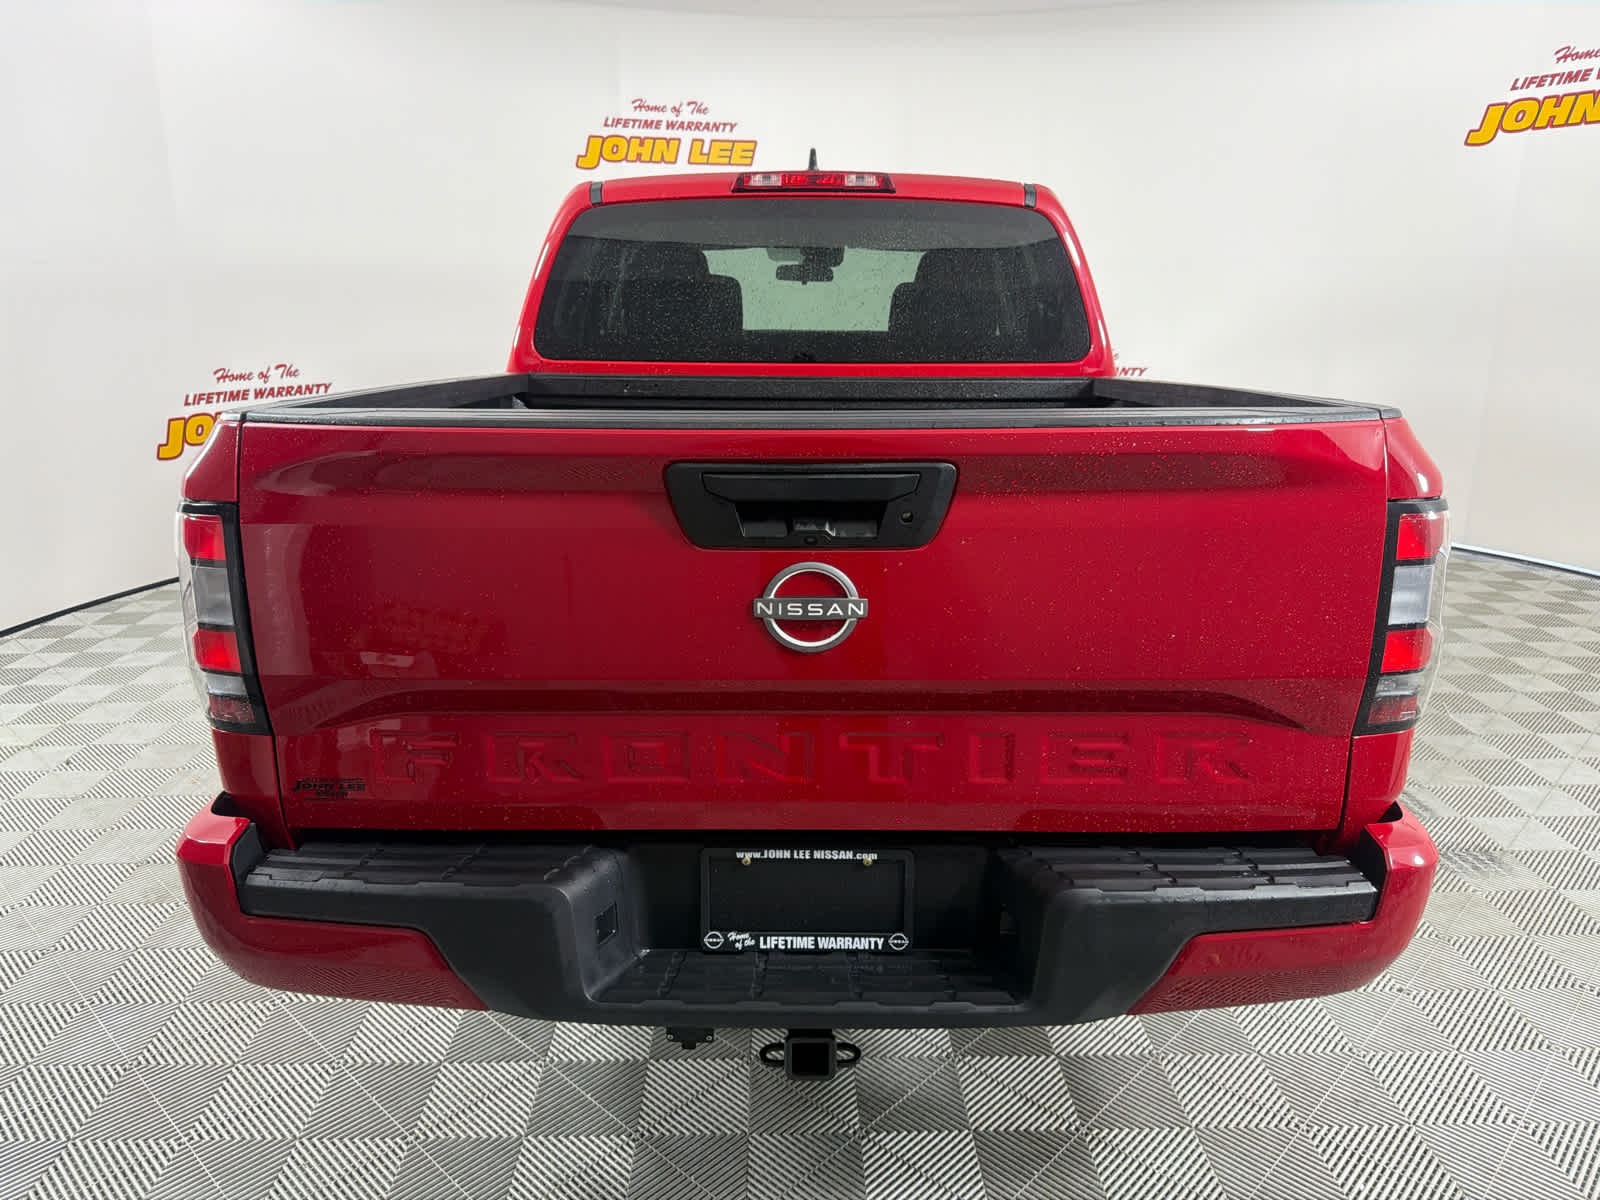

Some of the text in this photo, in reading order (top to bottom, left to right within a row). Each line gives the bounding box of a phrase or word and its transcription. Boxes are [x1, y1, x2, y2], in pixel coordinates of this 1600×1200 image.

[1510, 67, 1594, 92] LIFETIME
[632, 98, 710, 117] Home of The
[604, 117, 738, 133] LIFETIME WARRANTY
[576, 134, 757, 169] JOHN LEE
[213, 363, 300, 384] Home of The
[184, 382, 333, 407] LIFETIME WARRANTY
[157, 411, 224, 460] JO
[756, 601, 865, 616] NISSAN
[370, 728, 1252, 786] FRONTIER
[793, 850, 811, 859] LEE
[759, 936, 815, 950] LIFETIME
[817, 937, 884, 950] WARRANTY
